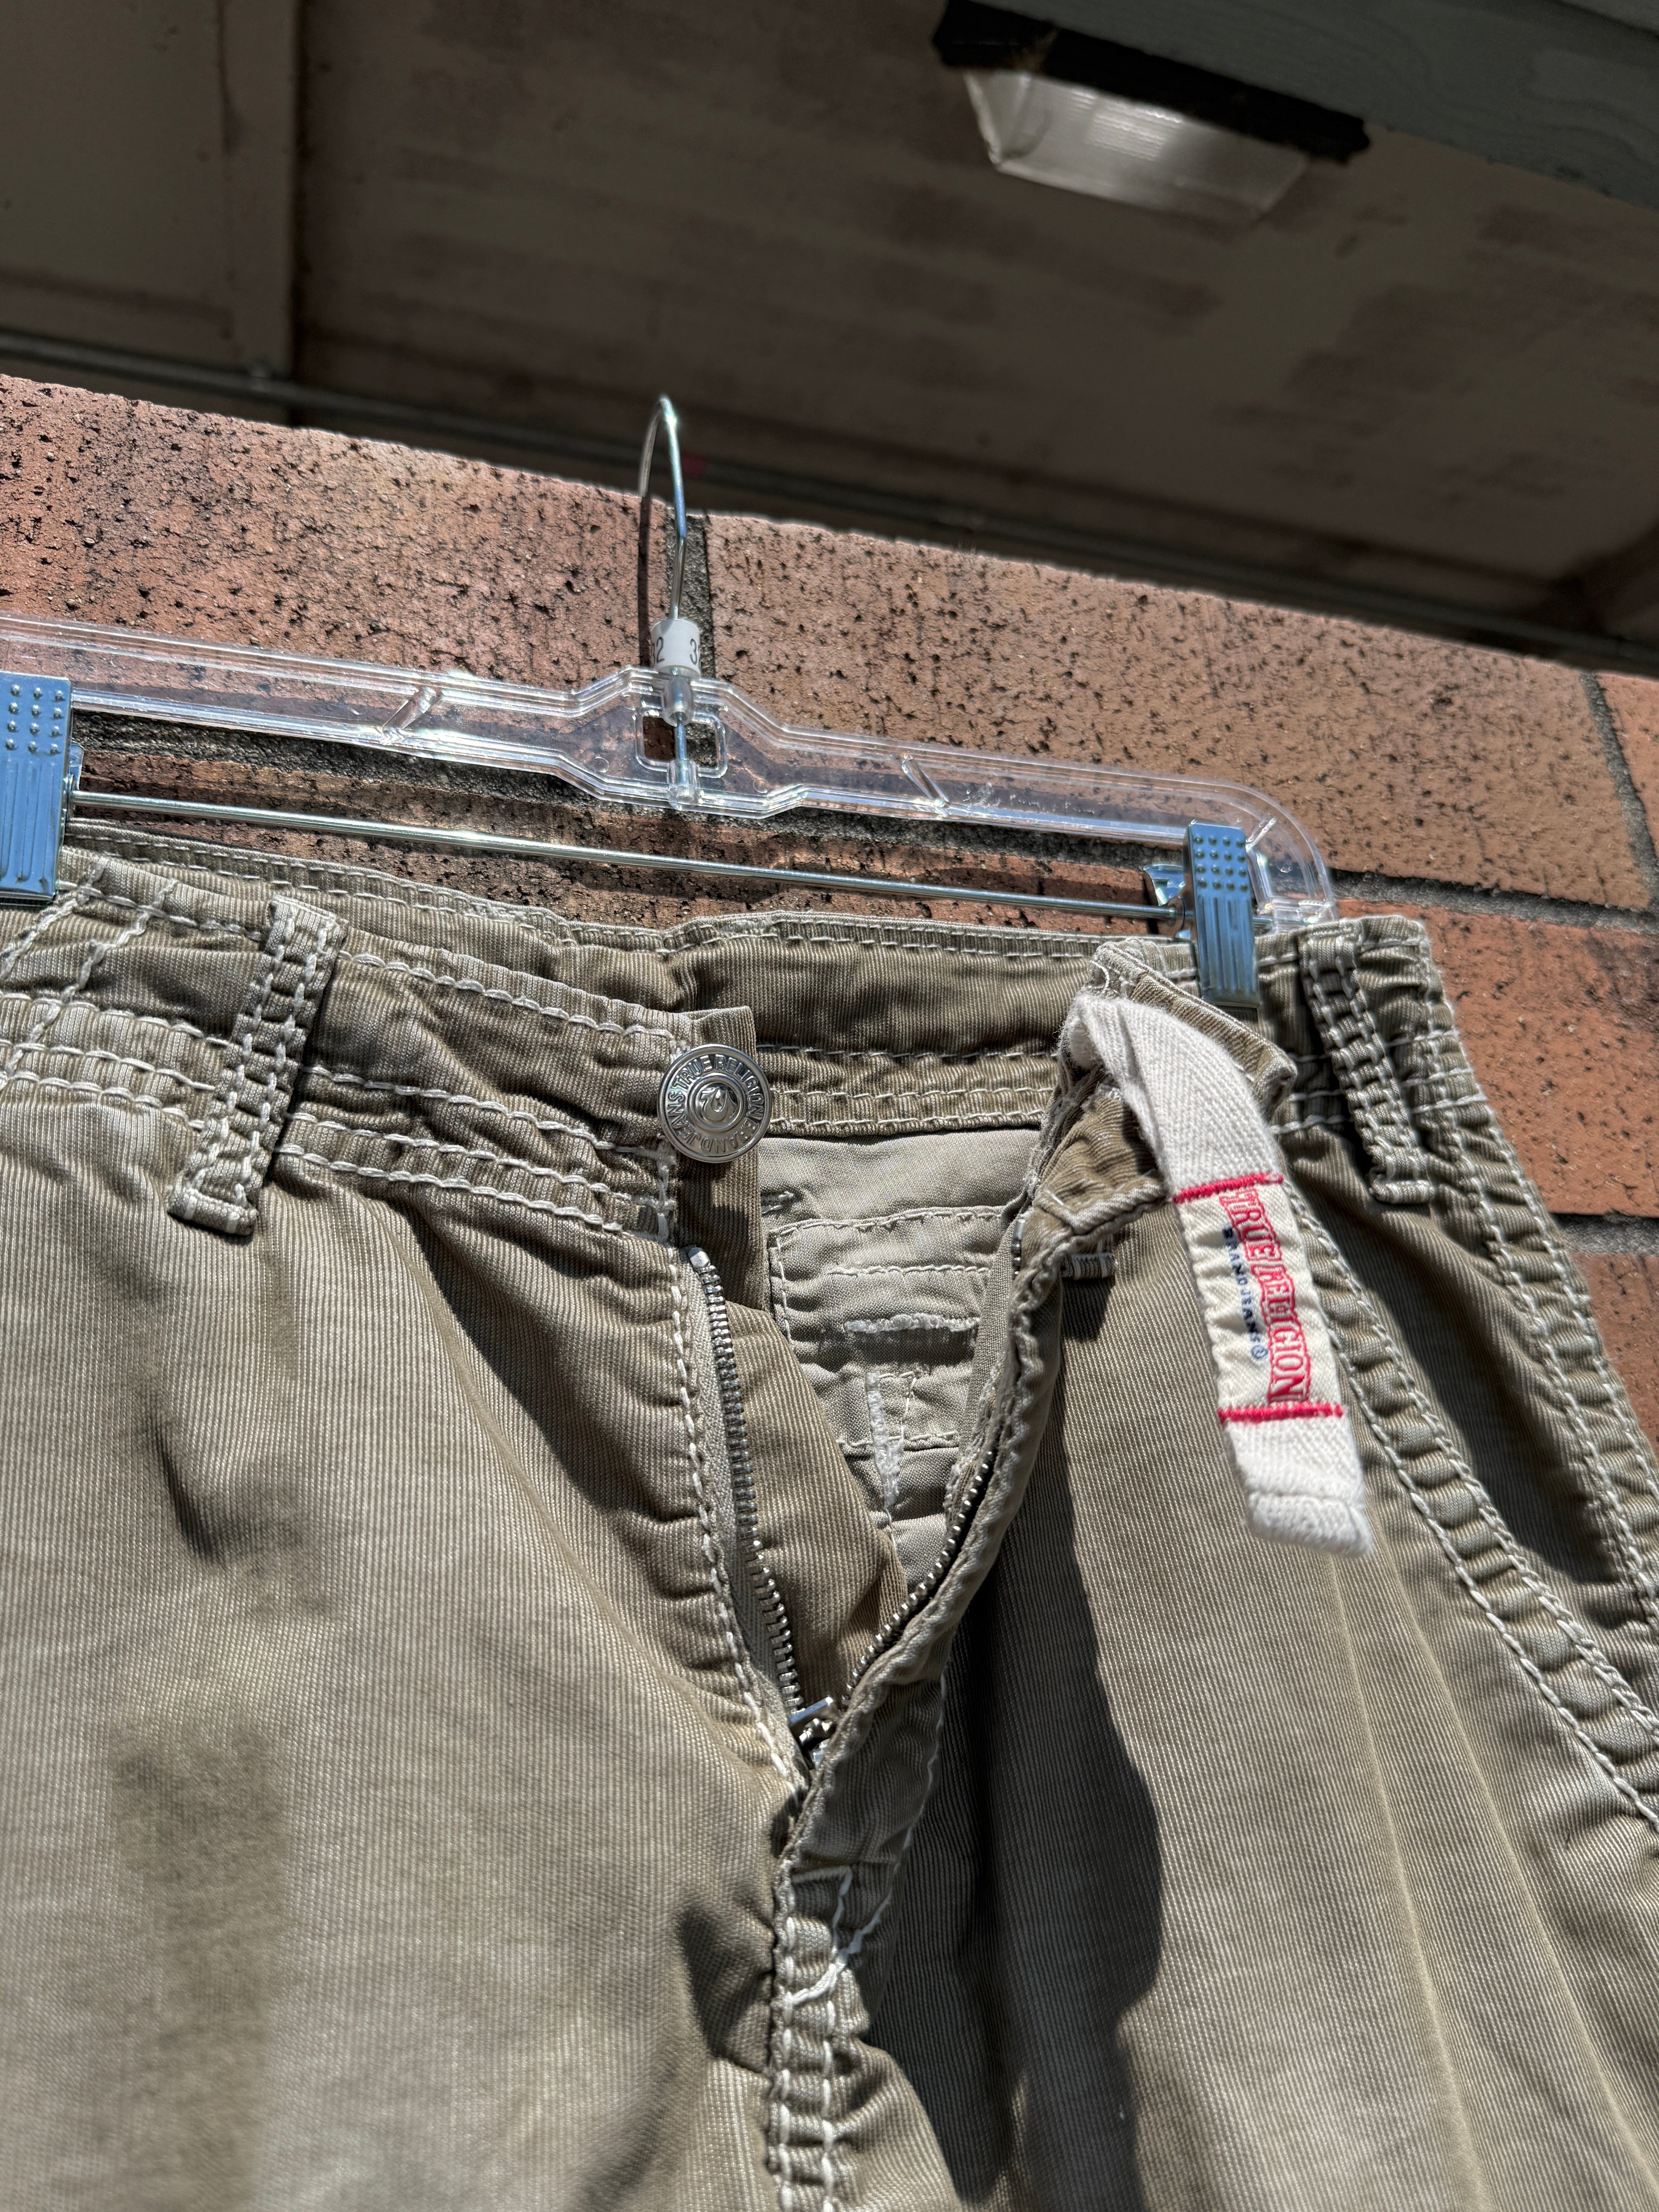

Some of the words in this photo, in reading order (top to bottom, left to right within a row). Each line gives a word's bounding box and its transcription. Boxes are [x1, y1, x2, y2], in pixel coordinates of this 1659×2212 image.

[690, 638, 701, 669] 3
[673, 1054, 713, 1090] TRUE
[715, 1054, 764, 1120] RELIGION
[668, 1090, 701, 1145] JEANS
[700, 1118, 760, 1154] BRAND
[1223, 1226, 1248, 1286] BRAND
[1219, 1188, 1282, 1262] TRUE
[1251, 1264, 1311, 1403] RELIGION
